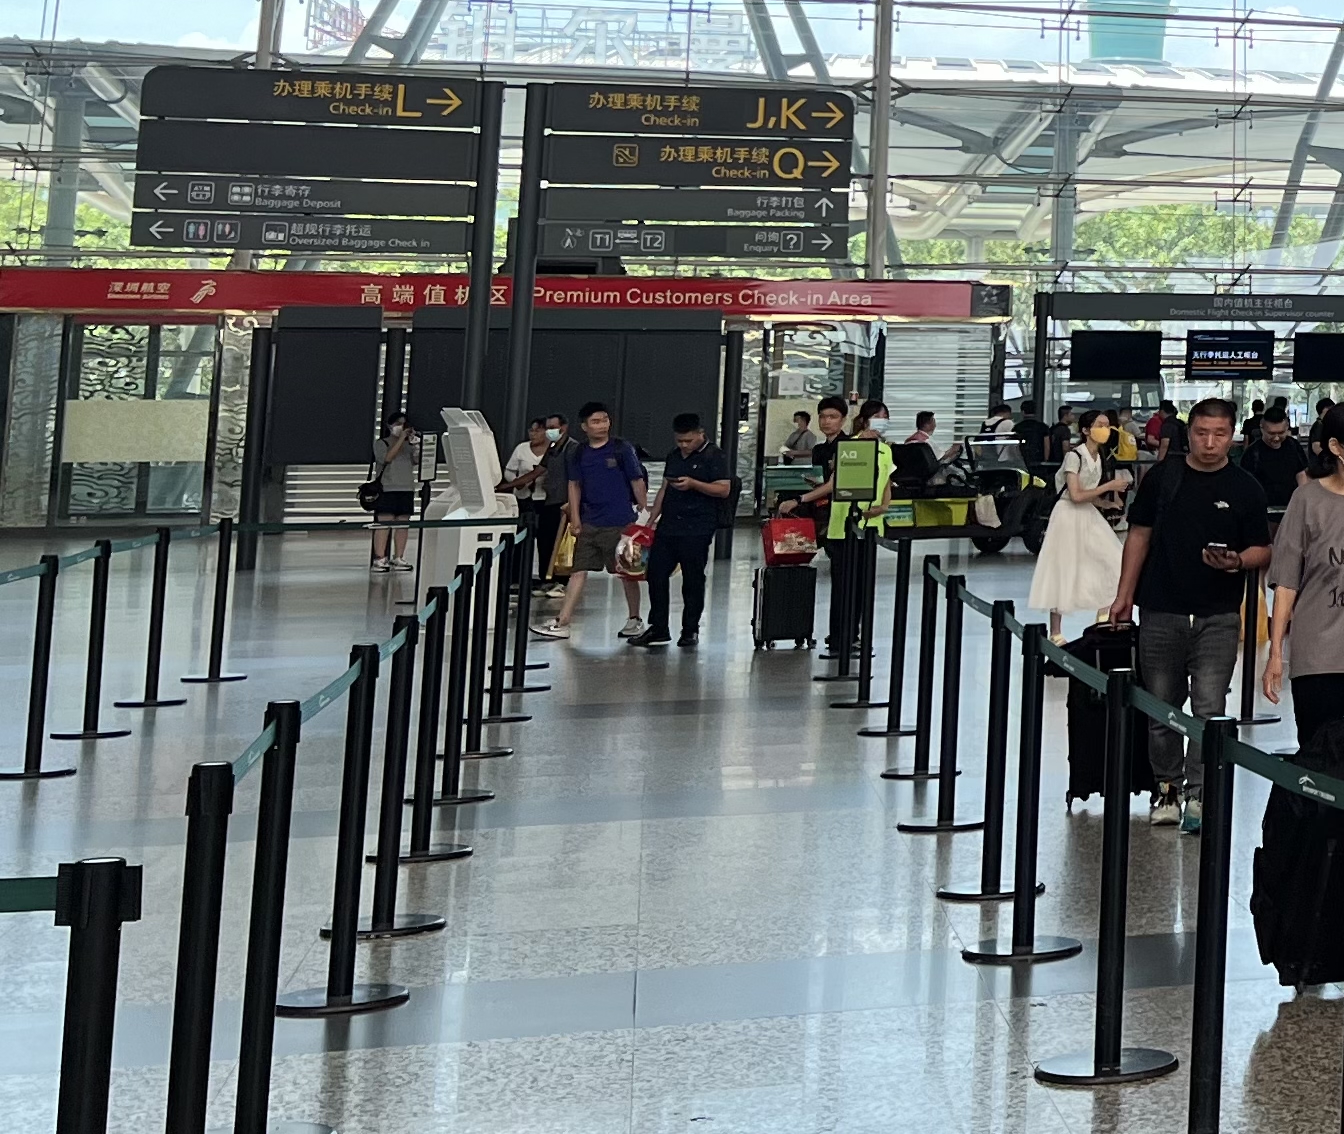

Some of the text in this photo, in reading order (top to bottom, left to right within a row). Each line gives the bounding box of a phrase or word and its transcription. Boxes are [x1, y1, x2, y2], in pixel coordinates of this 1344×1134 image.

[273, 79, 394, 101] 办理乘机手续
[396, 84, 423, 117] L
[589, 92, 700, 112] 办理乘机手续
[329, 102, 393, 116] Check-in
[641, 114, 700, 127] Check-in
[659, 145, 770, 165] 办理乘机手续
[772, 147, 805, 180] Q
[712, 166, 770, 179] Check-in
[256, 184, 312, 197] 行李寄存
[255, 198, 342, 209] Baggage Deposit
[756, 196, 805, 208] 行李打包
[727, 208, 805, 219] Baggage Packing
[289, 236, 430, 249] Oversized Baggage Check in
[592, 234, 610, 248] T1
[644, 234, 662, 248] T2
[743, 243, 779, 253] Enquiry
[533, 286, 872, 307] Premium Customers Check-in Area
[1170, 308, 1206, 317] Domestic
[1207, 308, 1230, 319] Flight
[1264, 309, 1305, 319] Supervisor
[840, 450, 858, 459] 入口
